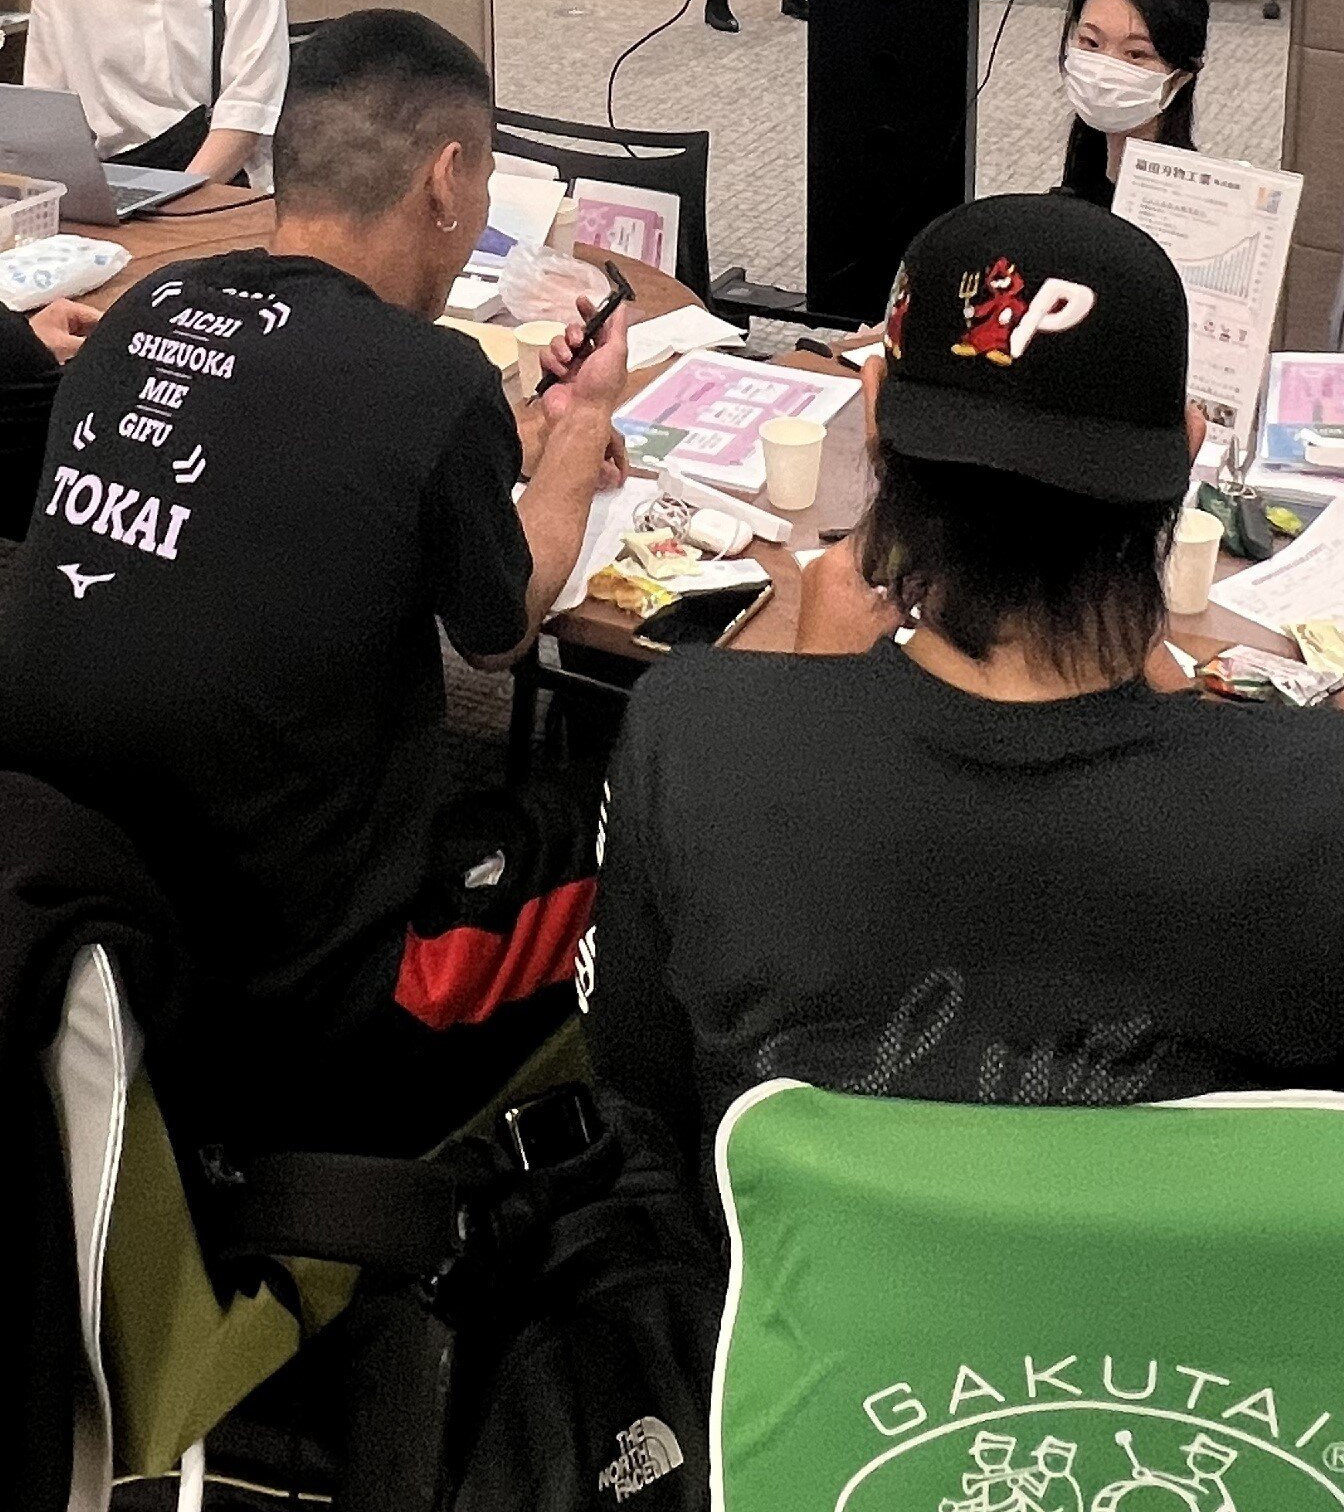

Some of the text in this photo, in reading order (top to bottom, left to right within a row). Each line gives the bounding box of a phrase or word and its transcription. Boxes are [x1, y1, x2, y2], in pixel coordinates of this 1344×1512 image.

[169, 307, 244, 338] AICHI
[127, 331, 237, 379] SHIZUOKA
[138, 376, 190, 409] MIE
[118, 412, 173, 447] GIFU
[44, 465, 192, 560] TOKAI
